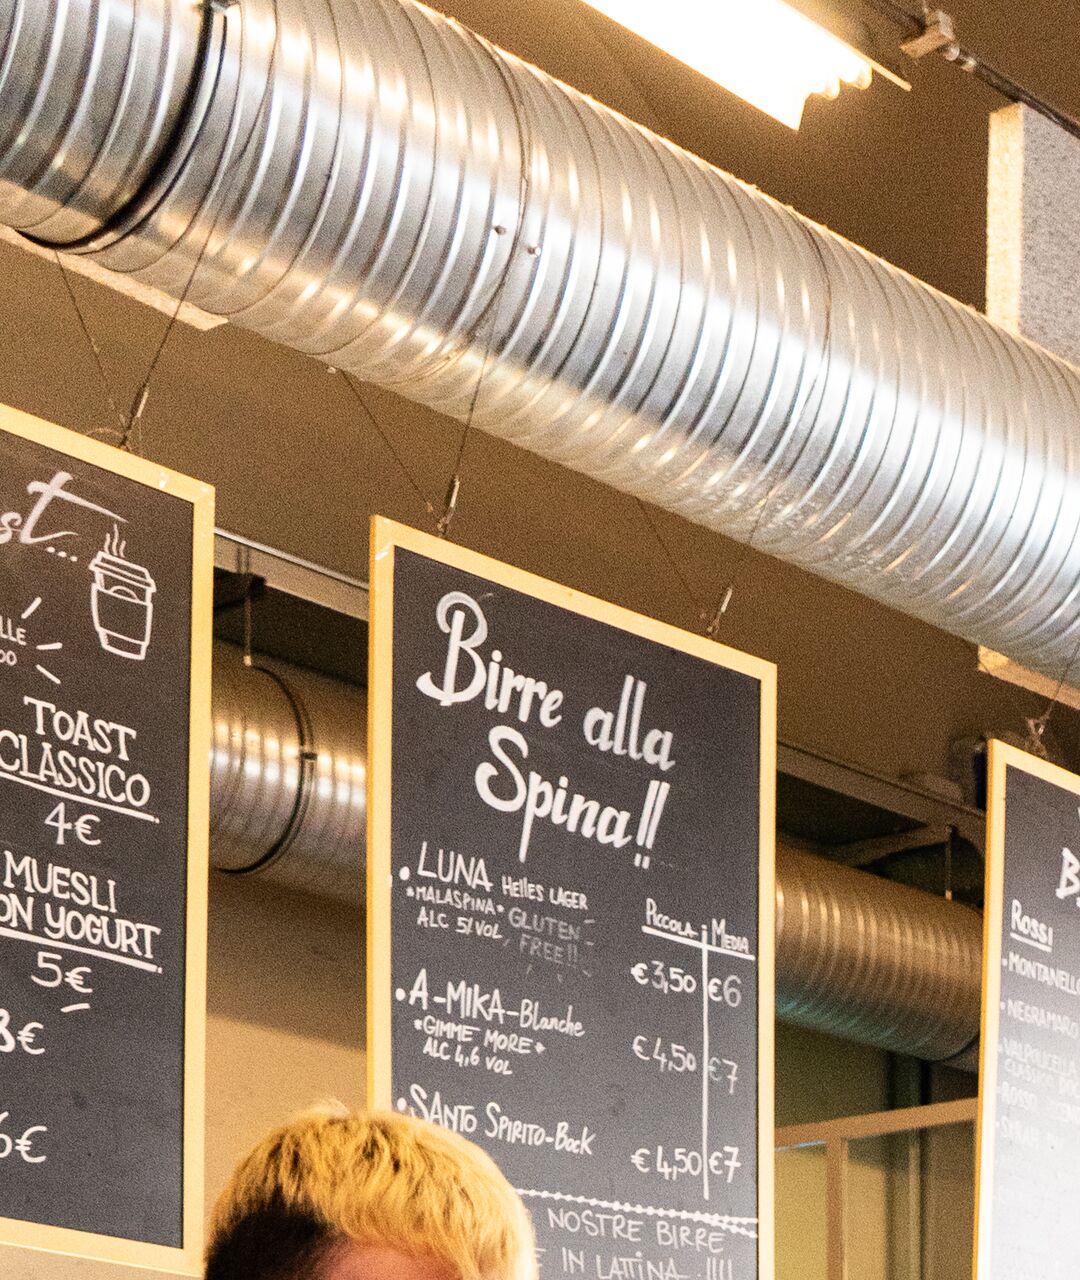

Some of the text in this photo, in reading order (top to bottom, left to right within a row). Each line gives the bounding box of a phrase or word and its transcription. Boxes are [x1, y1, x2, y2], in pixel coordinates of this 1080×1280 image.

[416, 591, 676, 771] Birre alla
[24, 695, 138, 762] TOAST
[0, 729, 151, 807] CLASSICO
[44, 801, 102, 846] 4€
[3, 849, 118, 914] MUESLI
[417, 841, 493, 893] LUNA
[549, 886, 589, 911] LAGER
[44, 902, 162, 960] YOGURT
[416, 905, 450, 928] ALC
[508, 907, 582, 940] GLUTEN
[1010, 899, 1054, 944] ROSSI
[30, 951, 94, 995] 5€
[708, 974, 742, 1008] €6
[422, 1037, 451, 1060] ALC
[485, 1056, 513, 1075] VOL
[423, 1015, 534, 1054] GIMME MORE
[409, 1083, 478, 1133] SANTO
[709, 1145, 742, 1183] €7
[547, 1207, 727, 1254] NOSTRE BIRRE
[562, 1247, 585, 1274] IN
